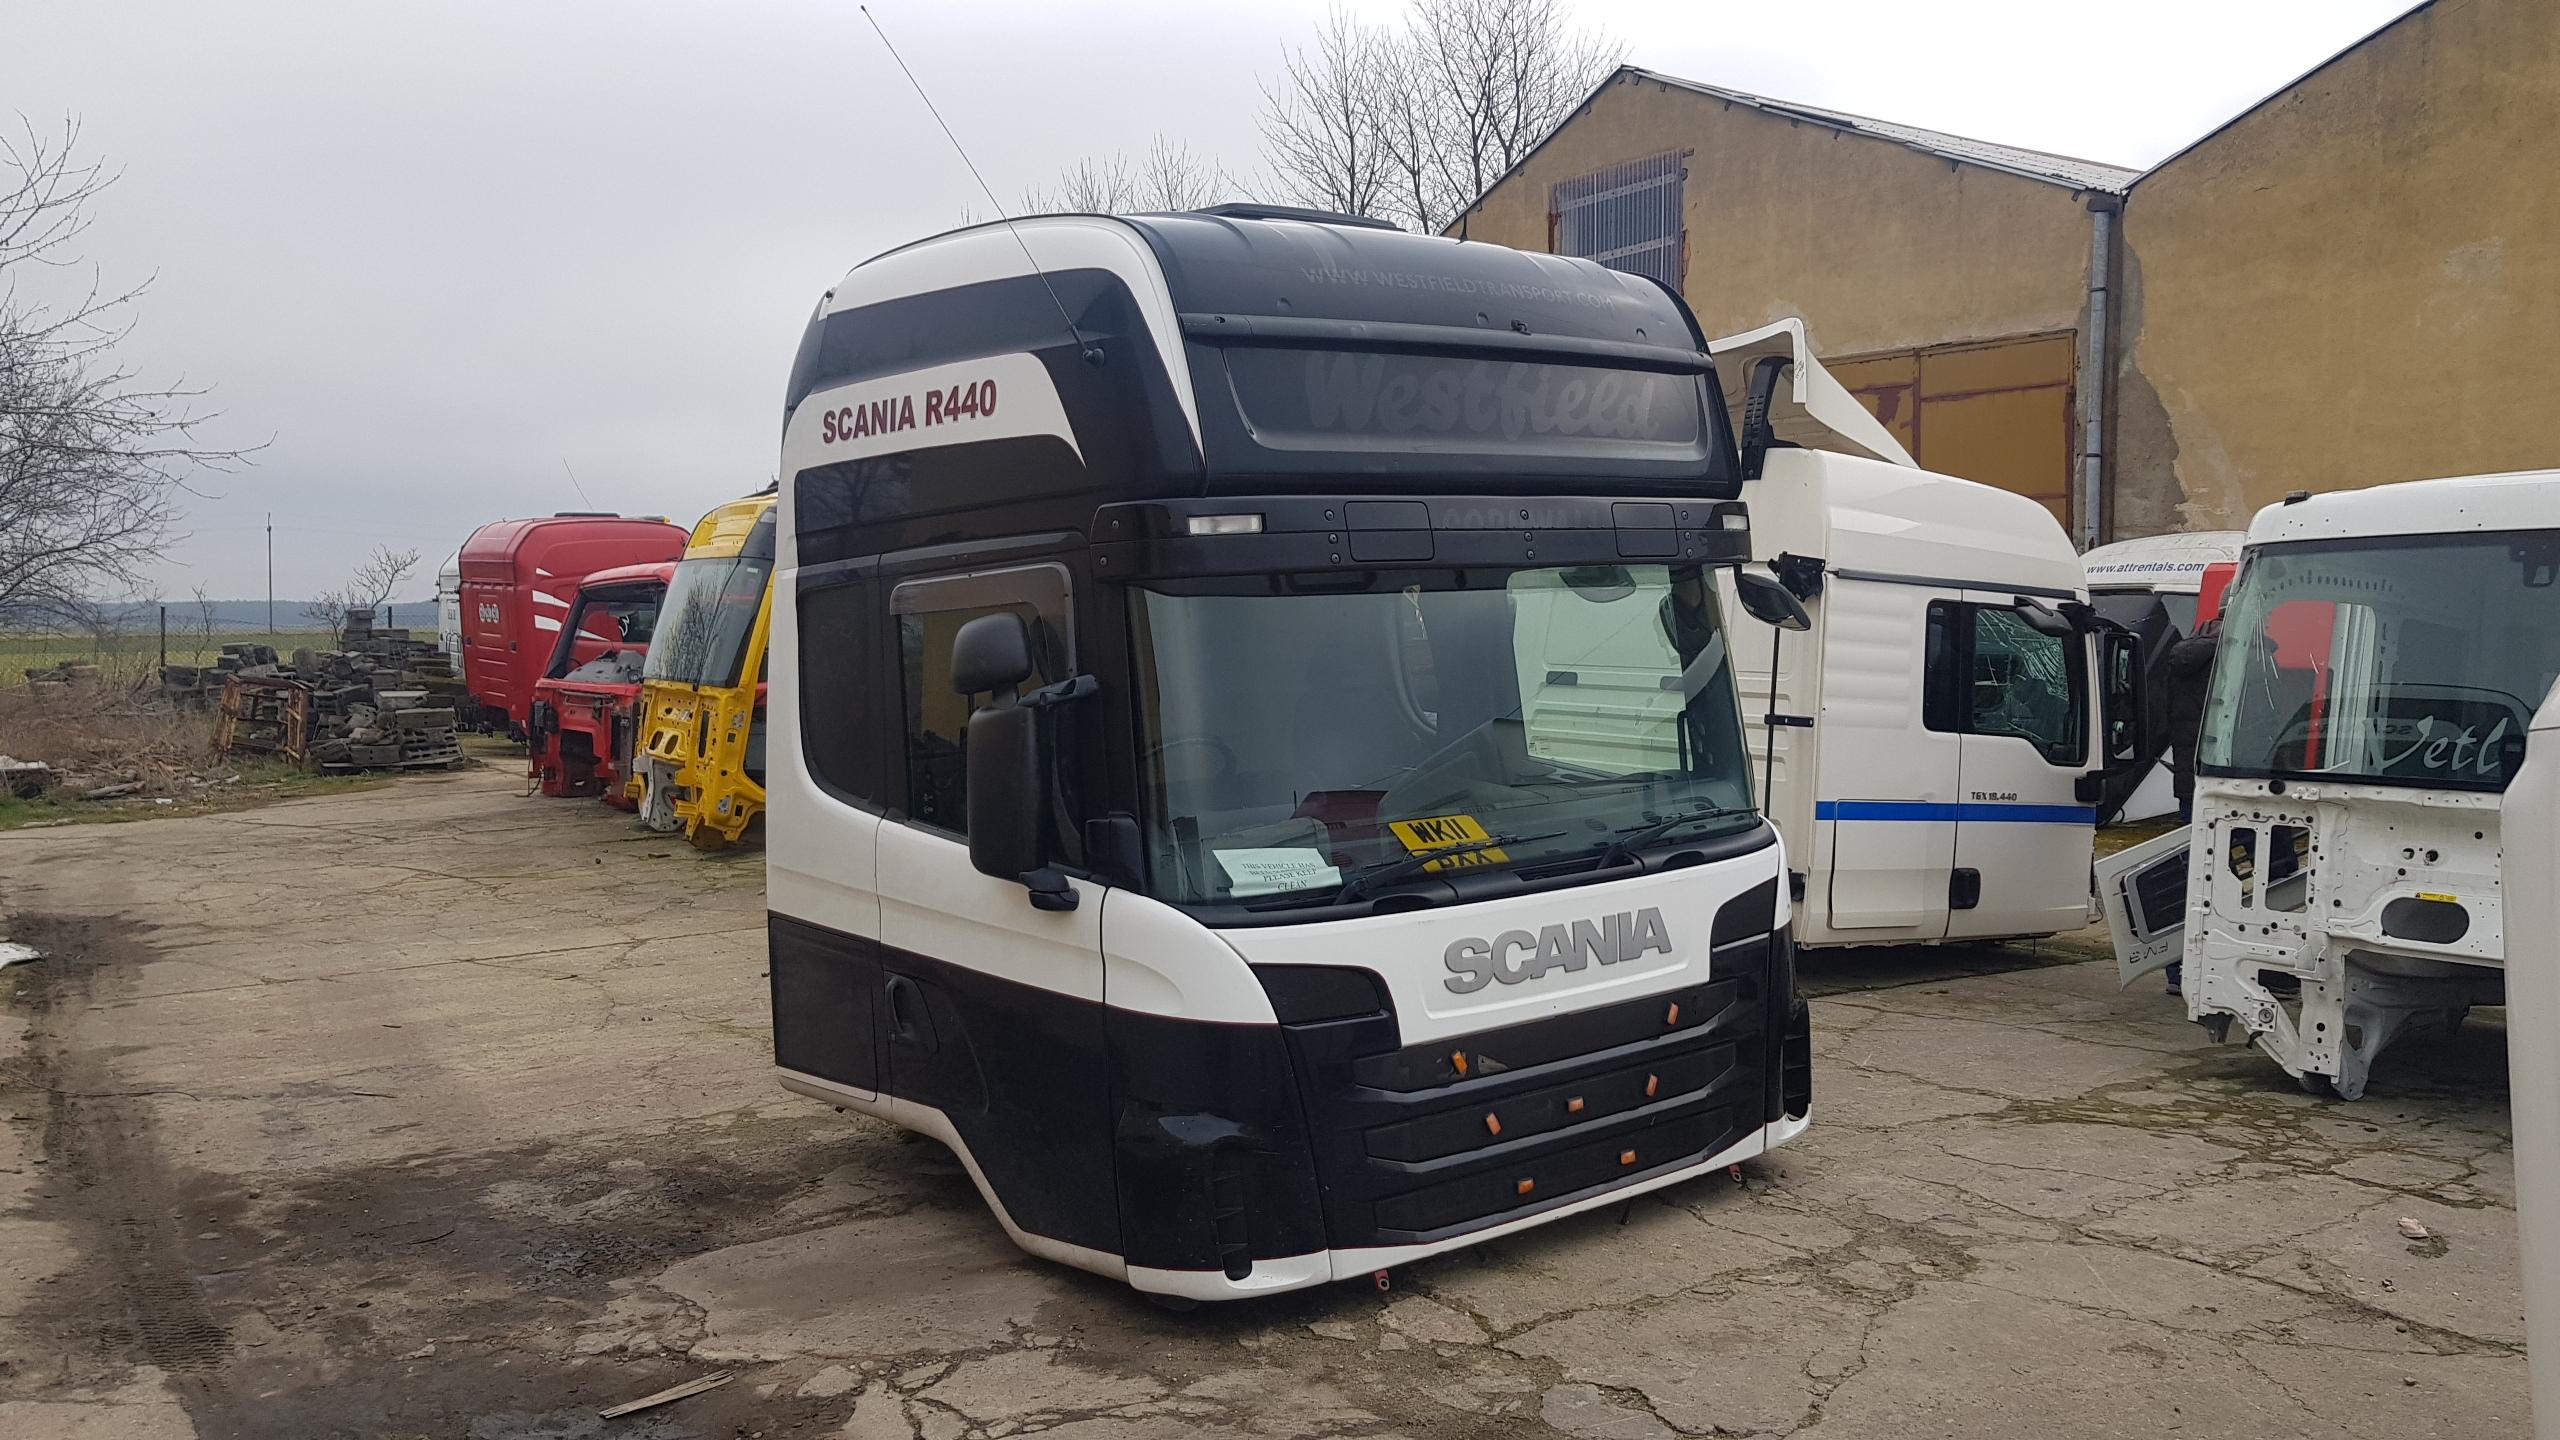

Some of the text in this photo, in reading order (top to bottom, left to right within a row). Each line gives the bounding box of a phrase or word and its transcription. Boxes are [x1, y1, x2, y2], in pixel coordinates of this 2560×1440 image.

[1304, 349, 1661, 441] Westfield
[822, 379, 997, 445] SCANIA R440
[2086, 561, 2205, 574] www.attrentals.com
[1970, 791, 1987, 801] TGX
[1263, 870, 1296, 882] PLEASE
[1277, 880, 1307, 891] CLEAN
[1444, 907, 1673, 995] SCANIA
